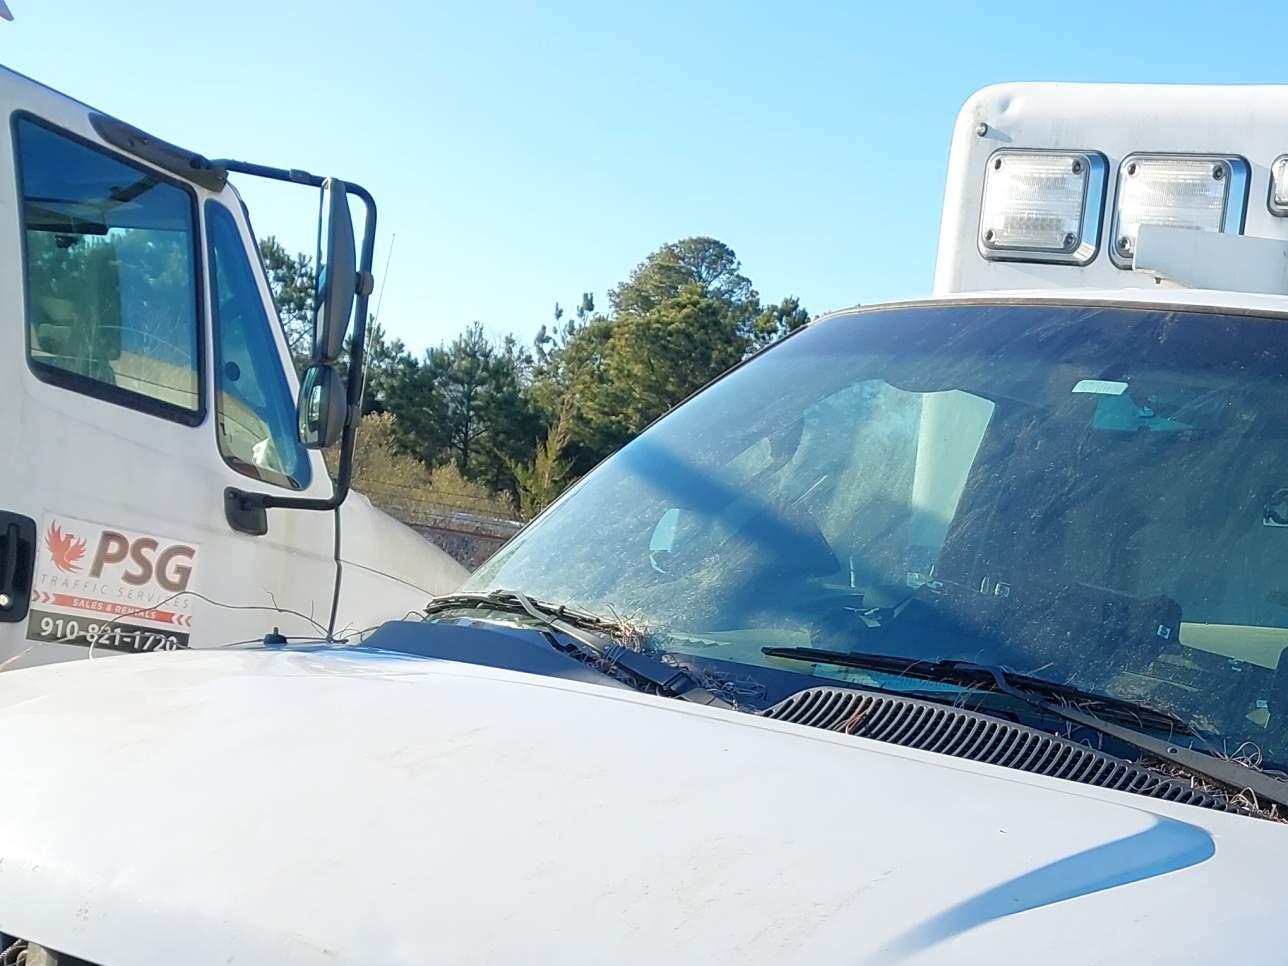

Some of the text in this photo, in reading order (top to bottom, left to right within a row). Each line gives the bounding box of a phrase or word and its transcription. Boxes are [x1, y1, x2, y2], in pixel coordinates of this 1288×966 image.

[88, 530, 196, 593] PSG
[40, 573, 193, 609] TRAFFIC SERVICES
[72, 598, 158, 620] SALES & RENTALS
[40, 616, 178, 652] 910-821-1720
